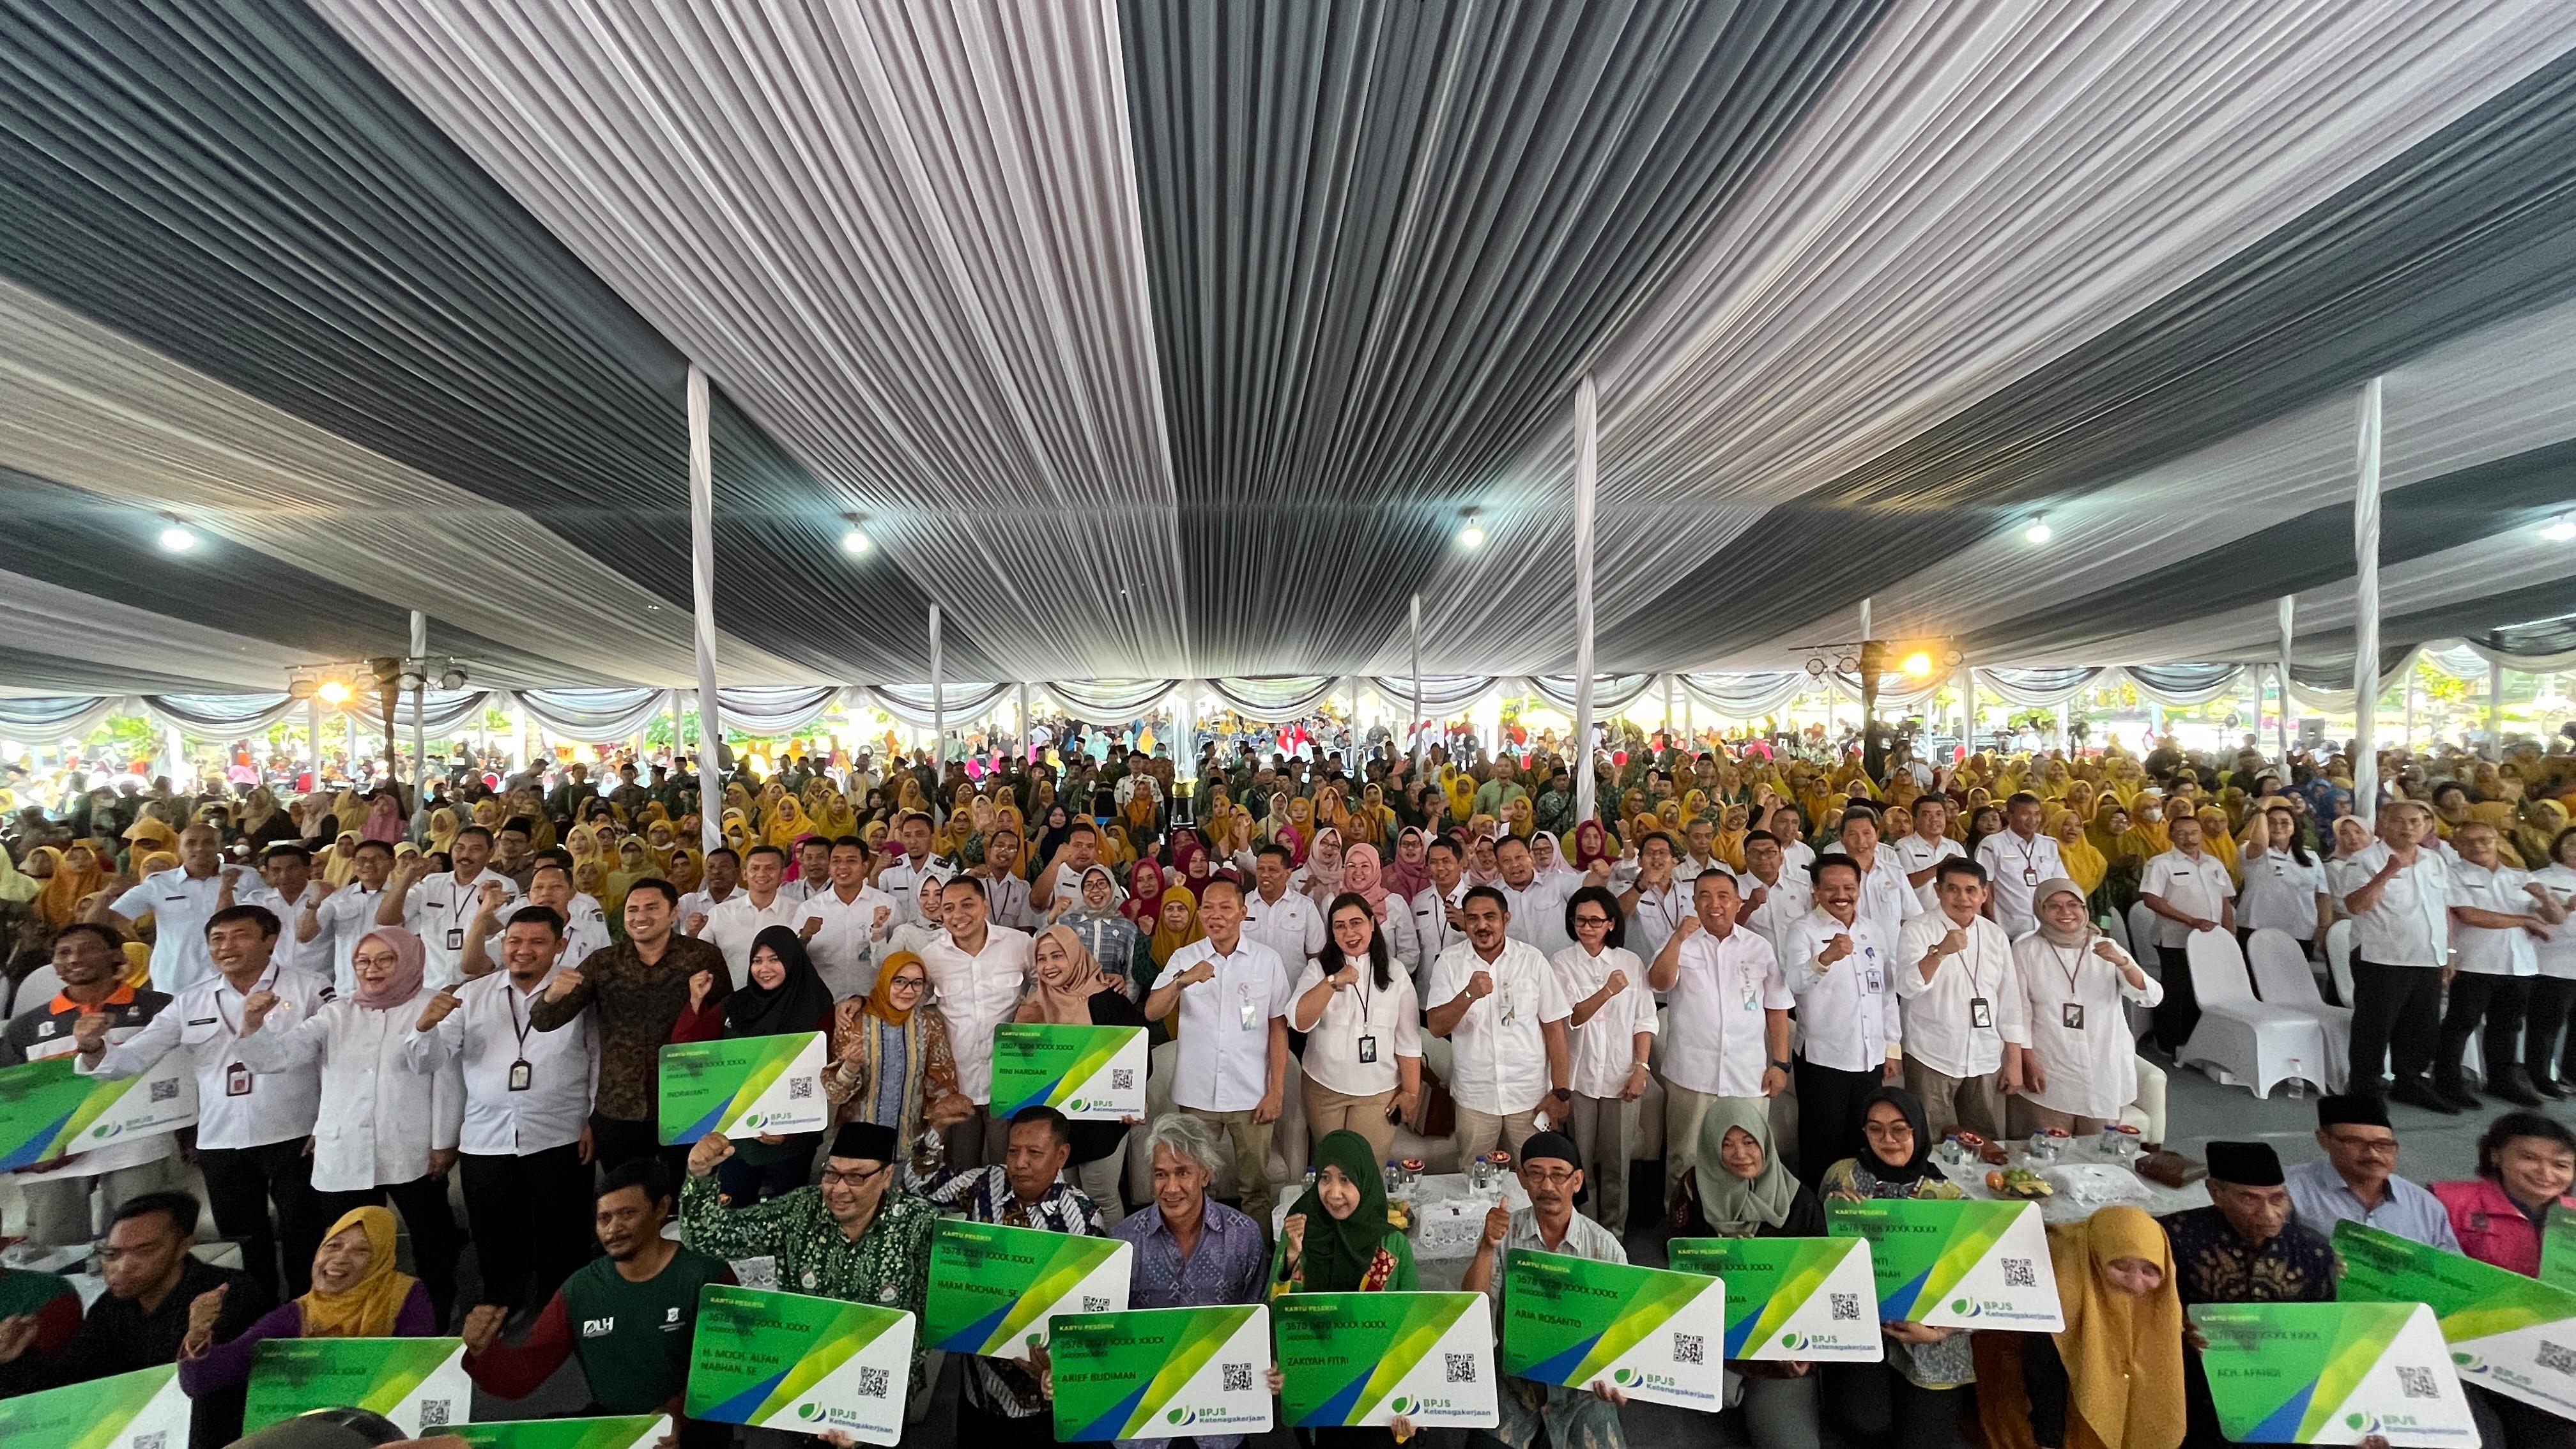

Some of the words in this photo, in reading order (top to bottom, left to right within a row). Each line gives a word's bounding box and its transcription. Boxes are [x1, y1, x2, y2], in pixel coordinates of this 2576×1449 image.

[770, 1112, 792, 1121] BPJS
[1913, 1225, 1938, 1233] XXXX
[986, 1252, 1009, 1262] XXXX
[1011, 1254, 1035, 1265] XXXX
[1750, 1263, 1774, 1271] XXXX
[938, 1280, 963, 1292] IMAM
[1591, 1288, 1618, 1299] XXXX
[1983, 1300, 2013, 1310] BPJS
[1333, 1321, 1358, 1329] XXXX
[1361, 1320, 1387, 1328] XXXX
[1538, 1312, 1582, 1328] ROSANTO
[1138, 1336, 1165, 1344] XXXX
[1812, 1335, 1837, 1344] BPJS
[750, 1354, 779, 1364] ALFAN
[1288, 1356, 1324, 1366] ZAKIYAH
[1327, 1356, 1349, 1365] FITRI
[1062, 1373, 1088, 1383] ARIEF
[1090, 1371, 1136, 1381] BUDIMAN
[1647, 1374, 1675, 1386] BPJS
[1646, 1383, 1715, 1400] Ketenagakerjaan
[1423, 1399, 1450, 1408] BPJS
[830, 1407, 857, 1420] BPJS
[1199, 1407, 1226, 1416] BPJS
[1423, 1407, 1491, 1417] Ketenagakerjaan
[1199, 1414, 1266, 1424] Ketenagakerjaan
[829, 1417, 894, 1434] Ketenagakerjaan
